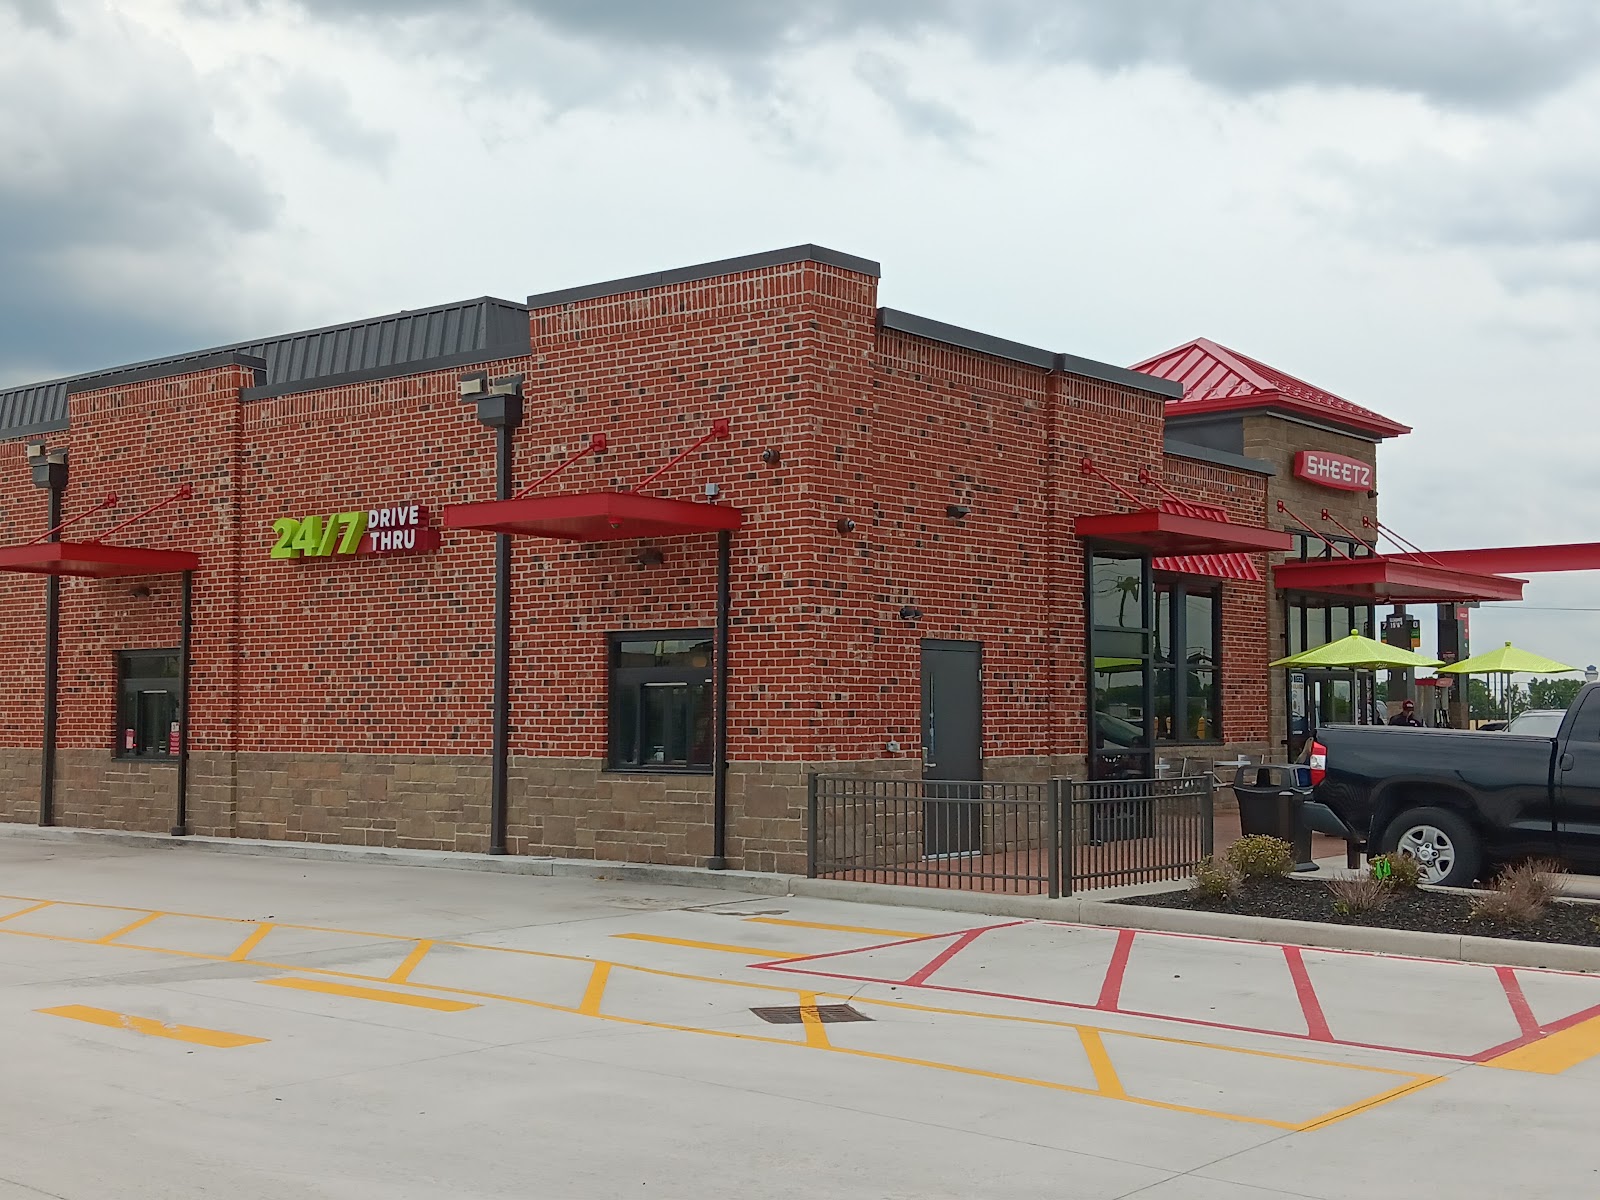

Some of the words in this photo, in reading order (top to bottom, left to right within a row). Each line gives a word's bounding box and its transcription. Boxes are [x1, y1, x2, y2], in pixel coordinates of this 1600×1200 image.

[1307, 455, 1370, 486] SHEETZ
[367, 505, 419, 528] DRIVE
[270, 511, 366, 559] 24/7
[369, 529, 416, 551] THRU
